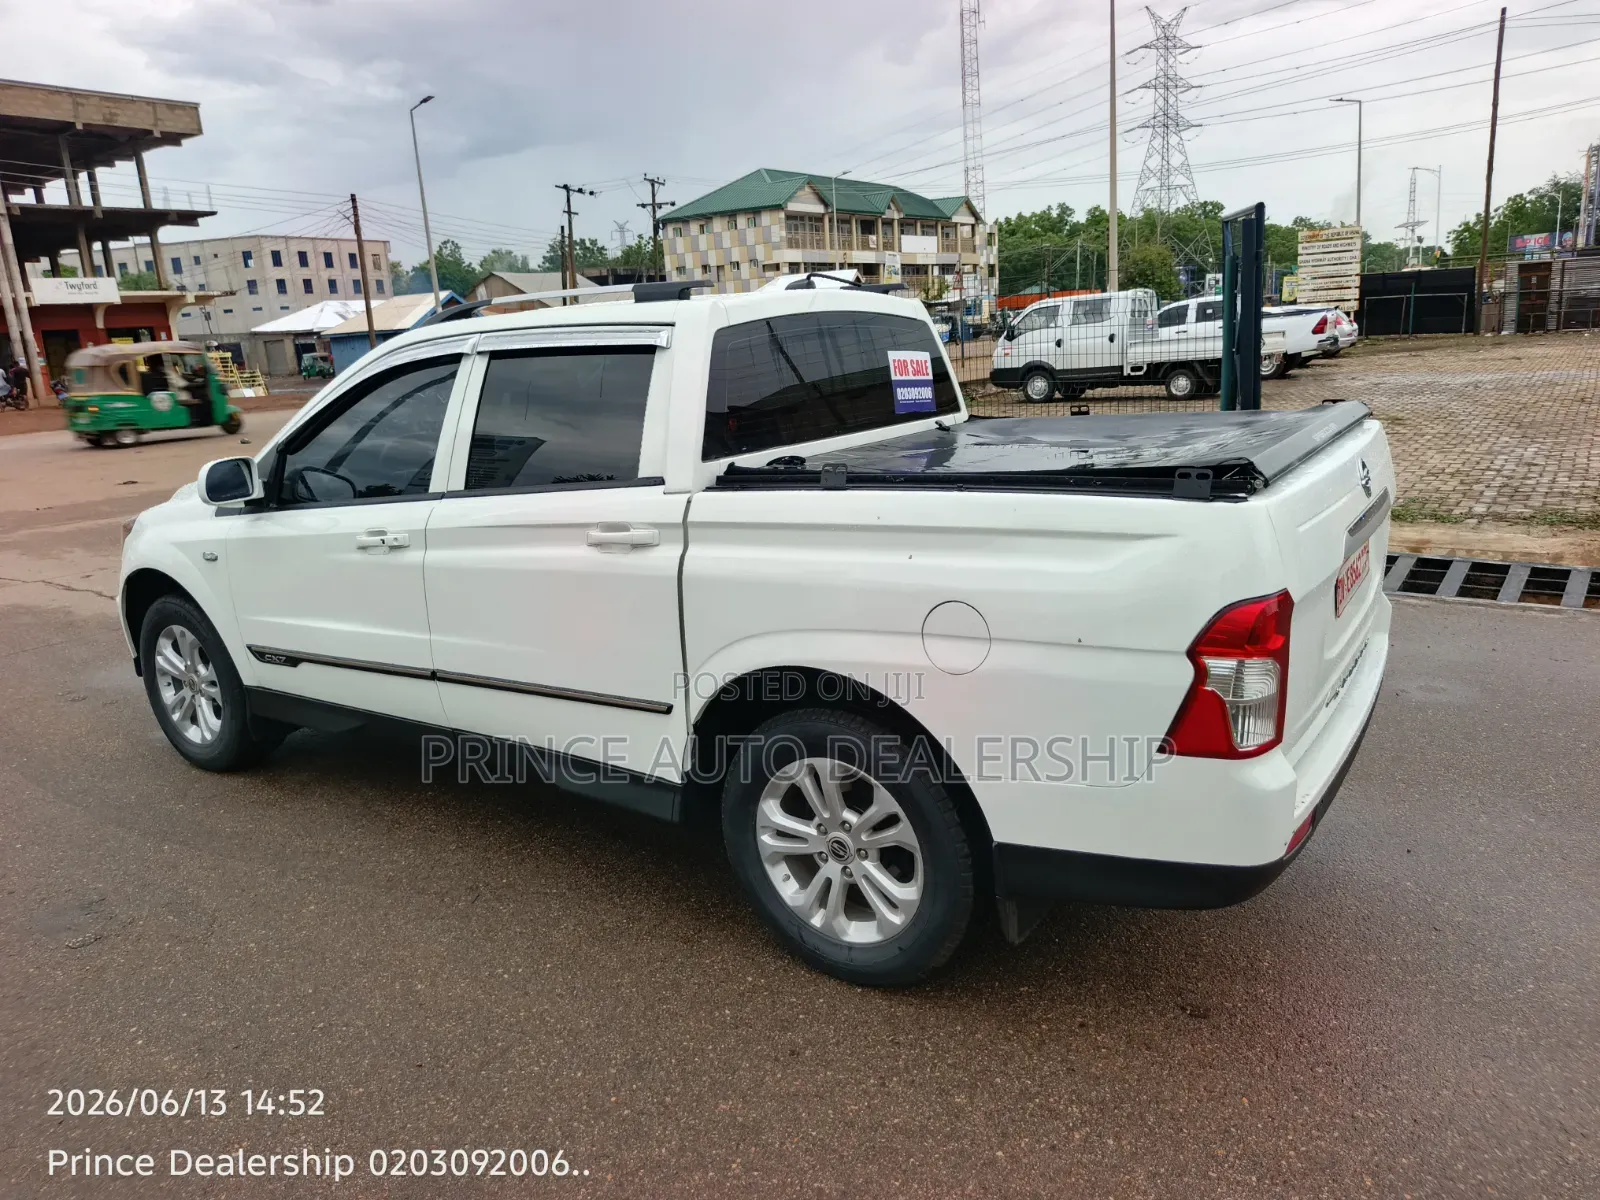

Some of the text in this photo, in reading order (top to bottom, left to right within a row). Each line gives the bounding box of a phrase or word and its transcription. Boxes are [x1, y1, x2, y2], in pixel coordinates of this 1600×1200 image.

[893, 358, 930, 377] FOR SALE
[264, 654, 287, 664] CX7
